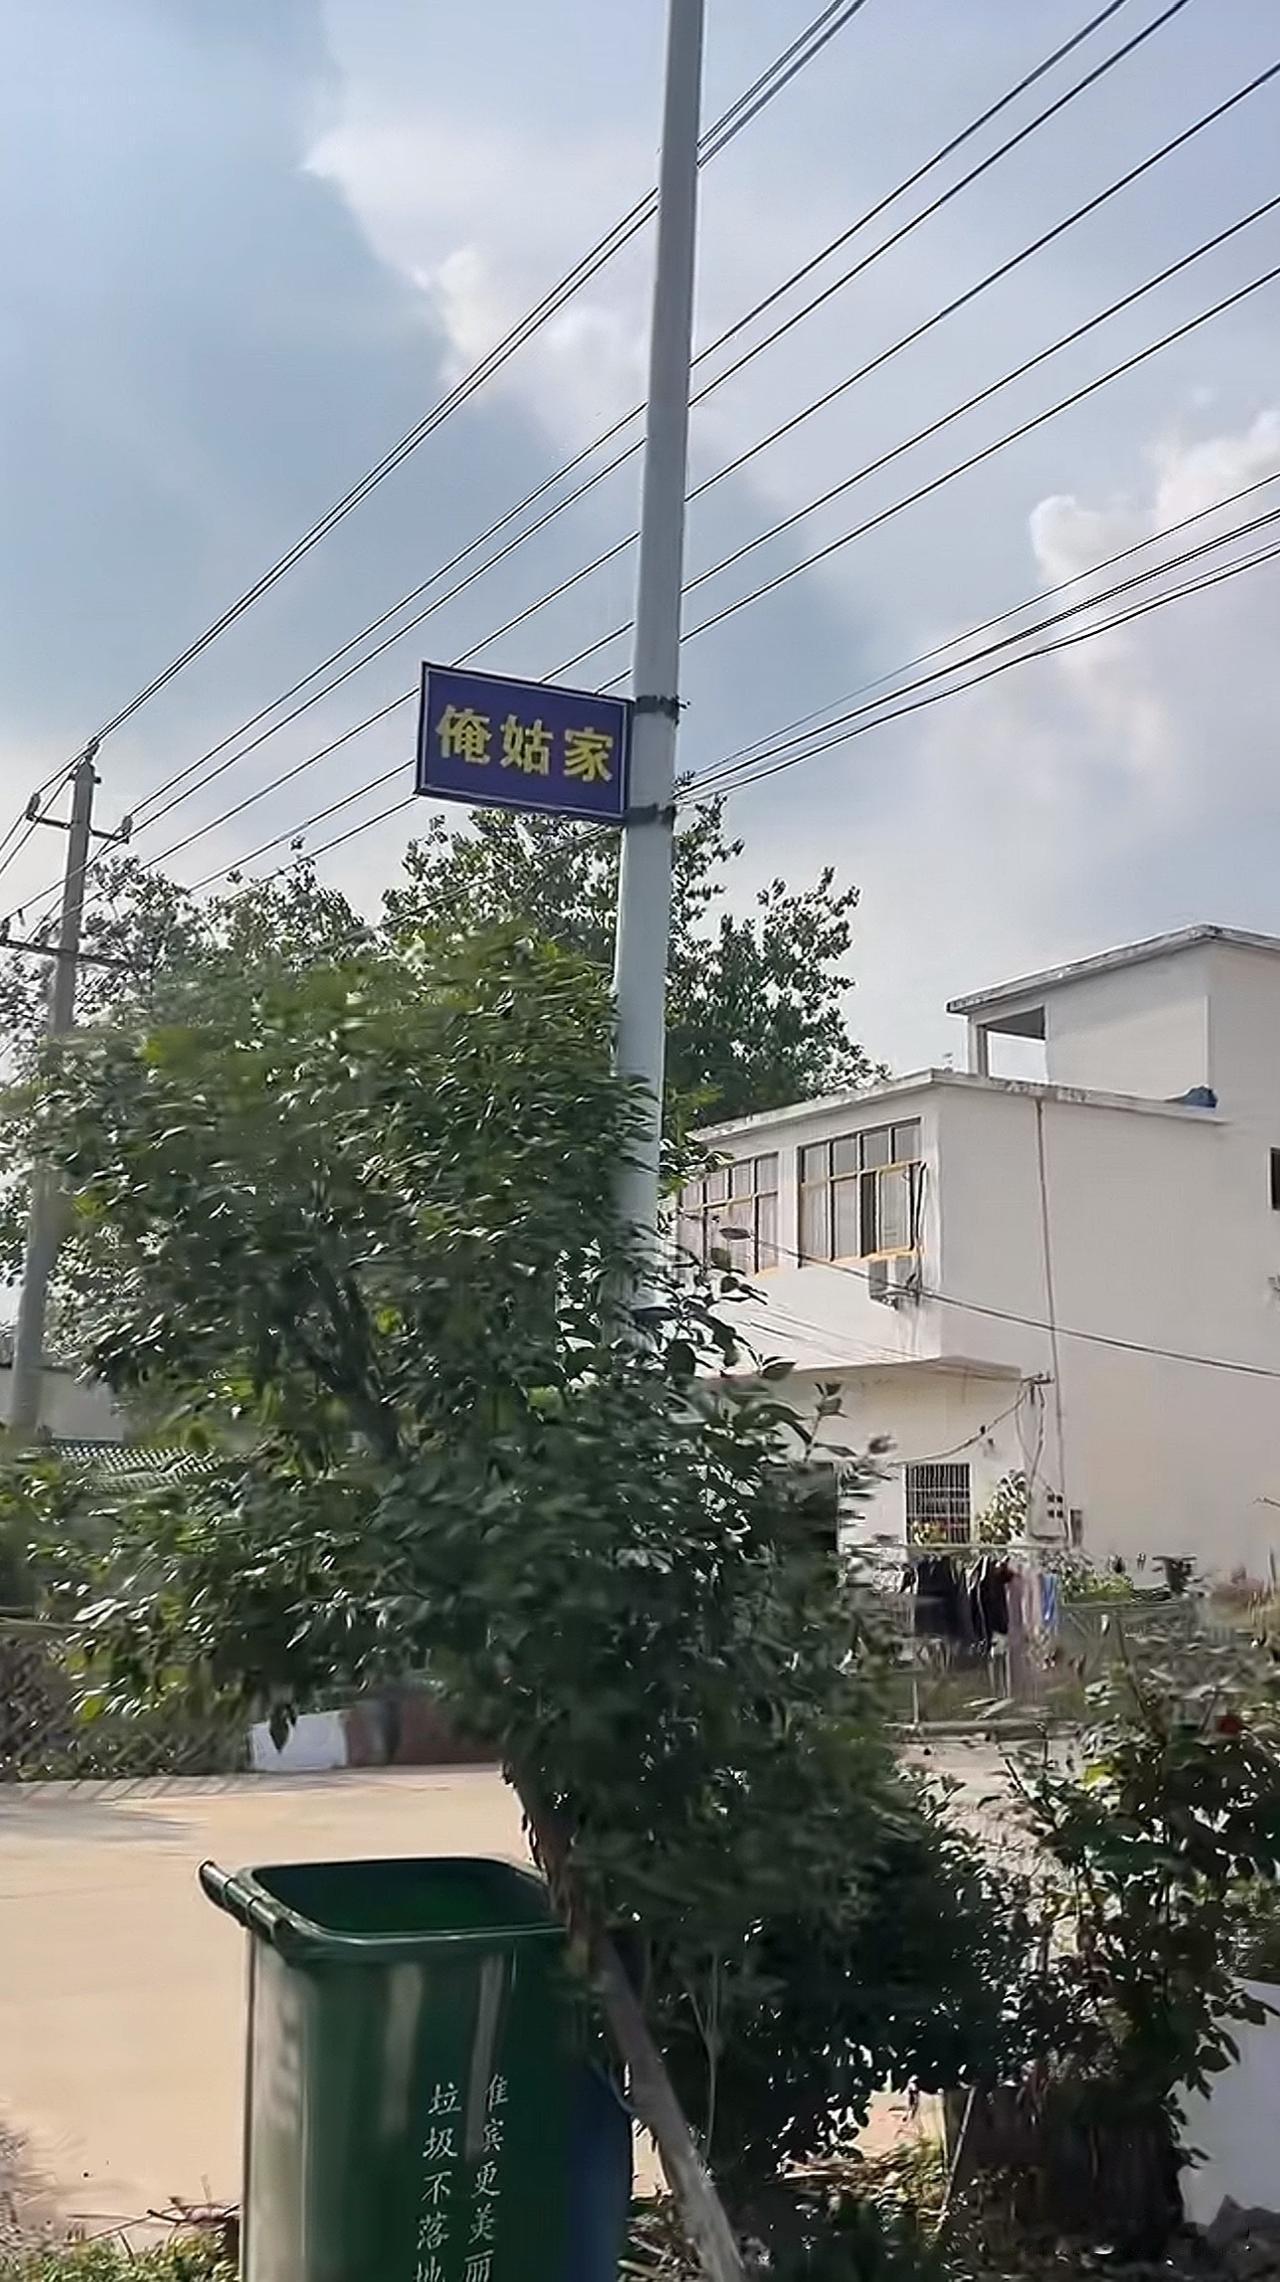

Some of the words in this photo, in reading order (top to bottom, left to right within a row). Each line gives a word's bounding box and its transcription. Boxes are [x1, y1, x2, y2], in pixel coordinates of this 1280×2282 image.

[435, 704, 614, 782] 俺姑家
[413, 2082, 462, 2282] 垃圾不落地
